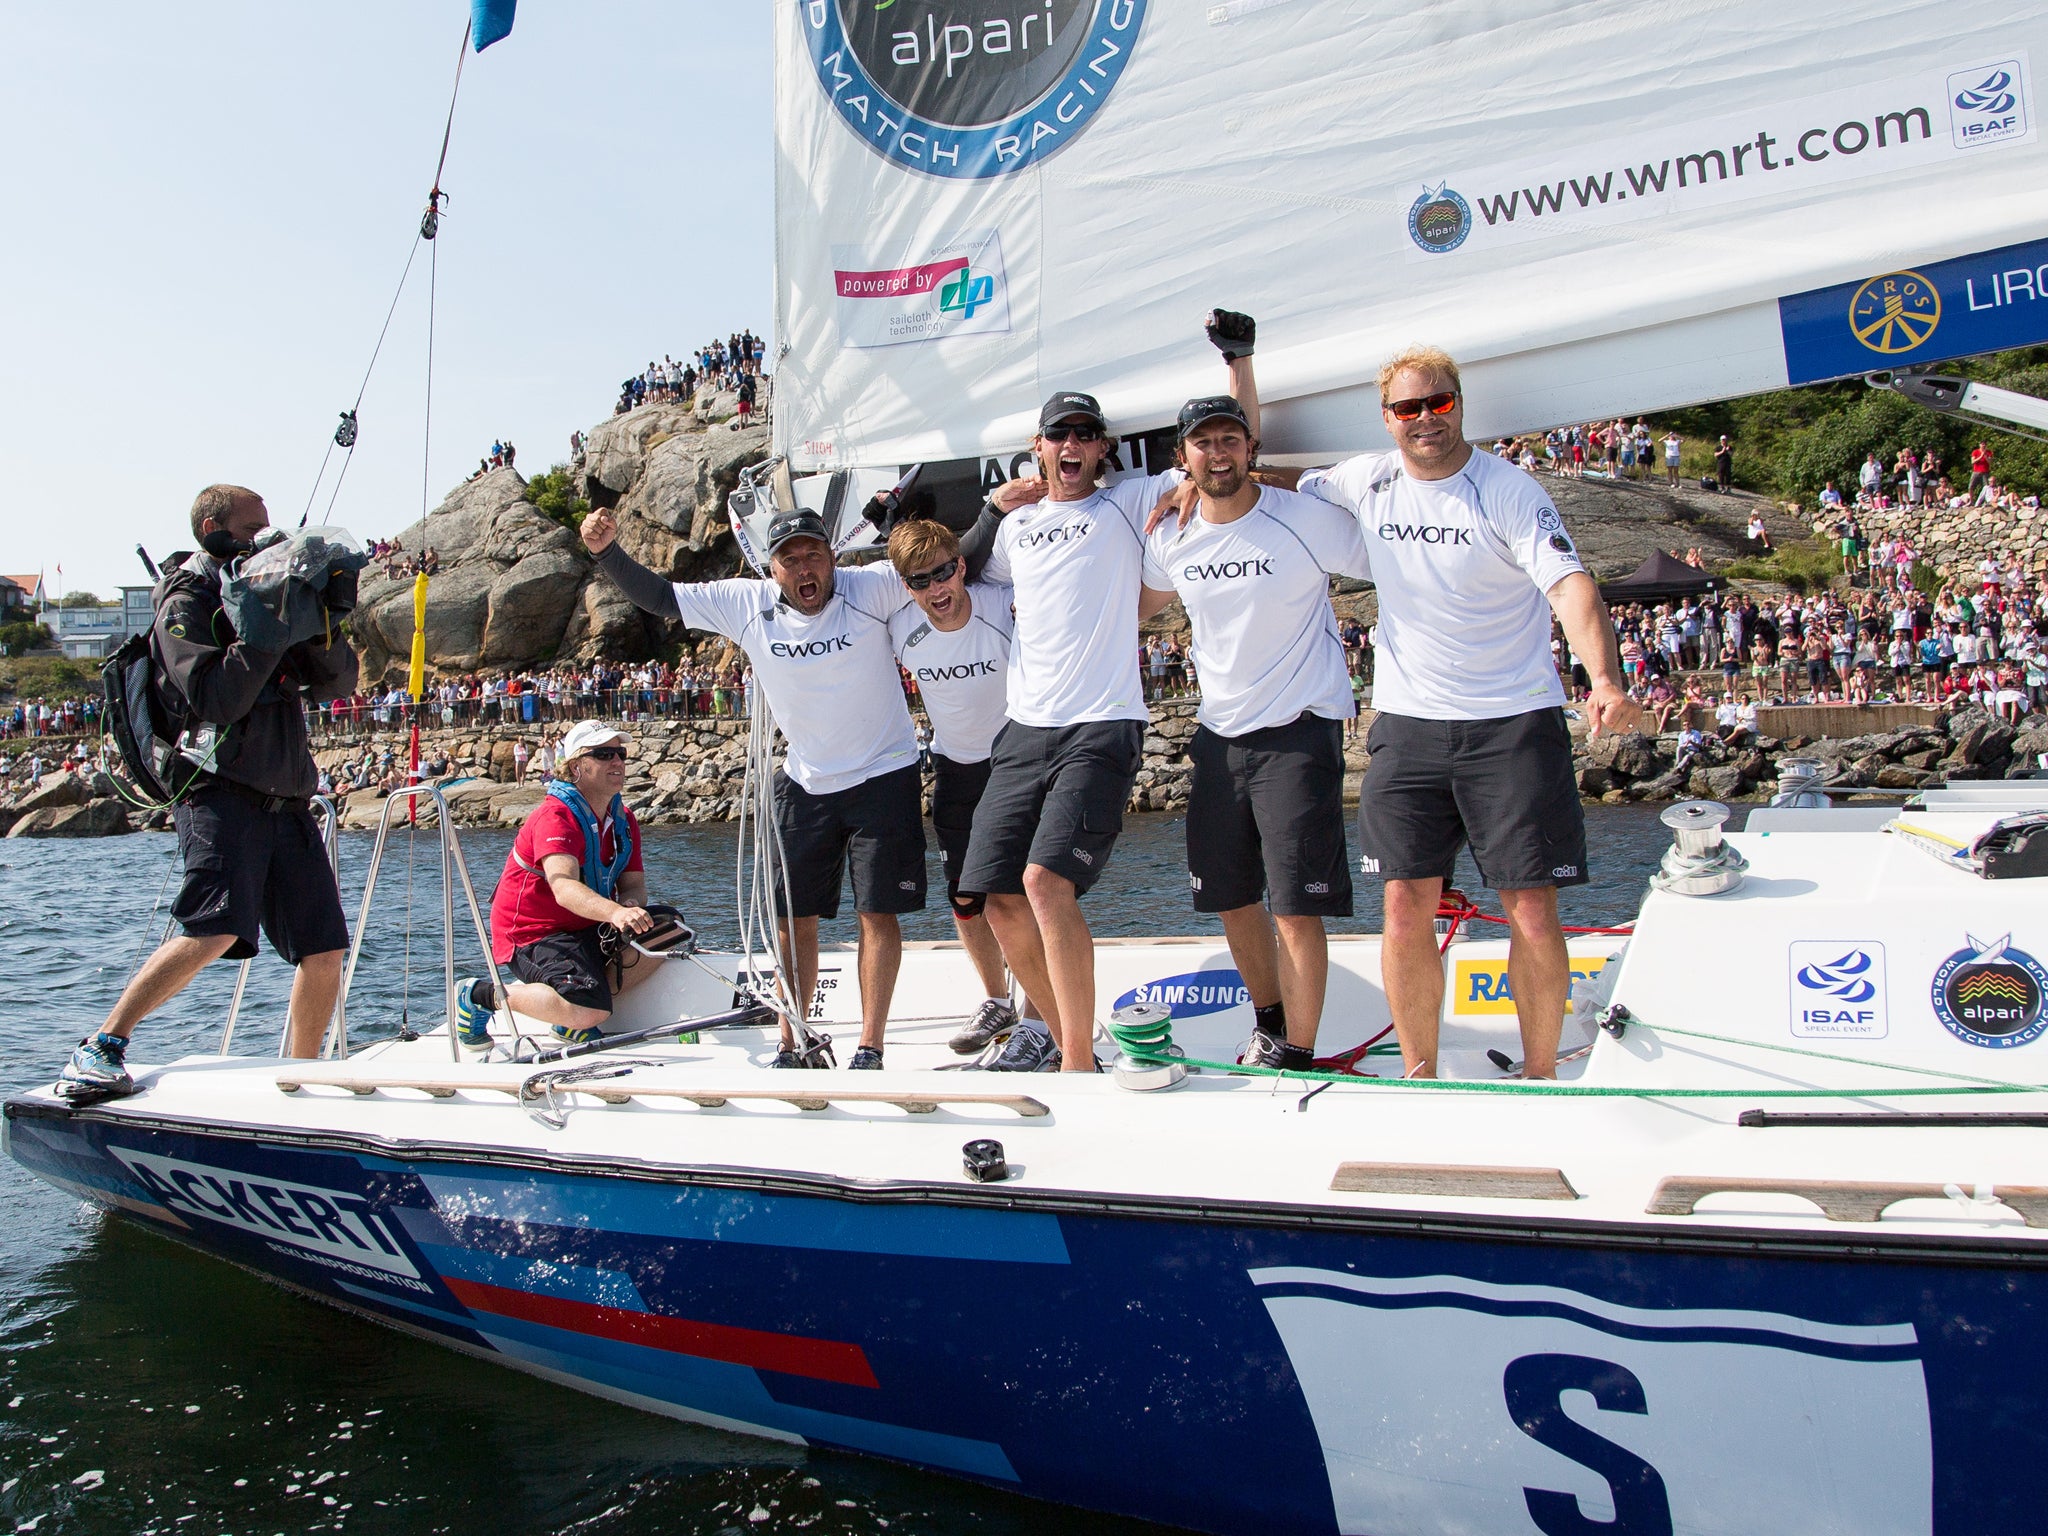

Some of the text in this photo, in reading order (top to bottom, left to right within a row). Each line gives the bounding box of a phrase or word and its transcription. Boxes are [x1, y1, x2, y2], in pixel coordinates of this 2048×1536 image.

[891, 0, 1053, 78] alpari
[823, 0, 1134, 166] MATCH RACING
[1962, 116, 2016, 137] ISAF
[1993, 129, 2015, 137] EVENT
[1477, 106, 1931, 225] www.wmrt.com
[1426, 224, 1456, 238] alpari
[843, 271, 933, 294] powered by
[1857, 280, 1930, 315] LIROS
[890, 310, 932, 326] sailcloth
[890, 321, 944, 336] technology
[982, 433, 1147, 491] ACRT
[1378, 523, 1472, 546] ework
[1183, 559, 1273, 581] ework
[770, 633, 853, 658] ework
[917, 660, 997, 681] ework
[1134, 984, 1249, 1005] SAMSUNG
[1933, 960, 1958, 1006] WORLD
[1803, 1010, 1874, 1024] ISAF
[1963, 1004, 2024, 1023] alpari
[1939, 1010, 1990, 1046] MATCH
[130, 1160, 402, 1257] ACKERT
[265, 1242, 434, 1295] REKLAMPRODUKTION
[1503, 1353, 1675, 1536] S
